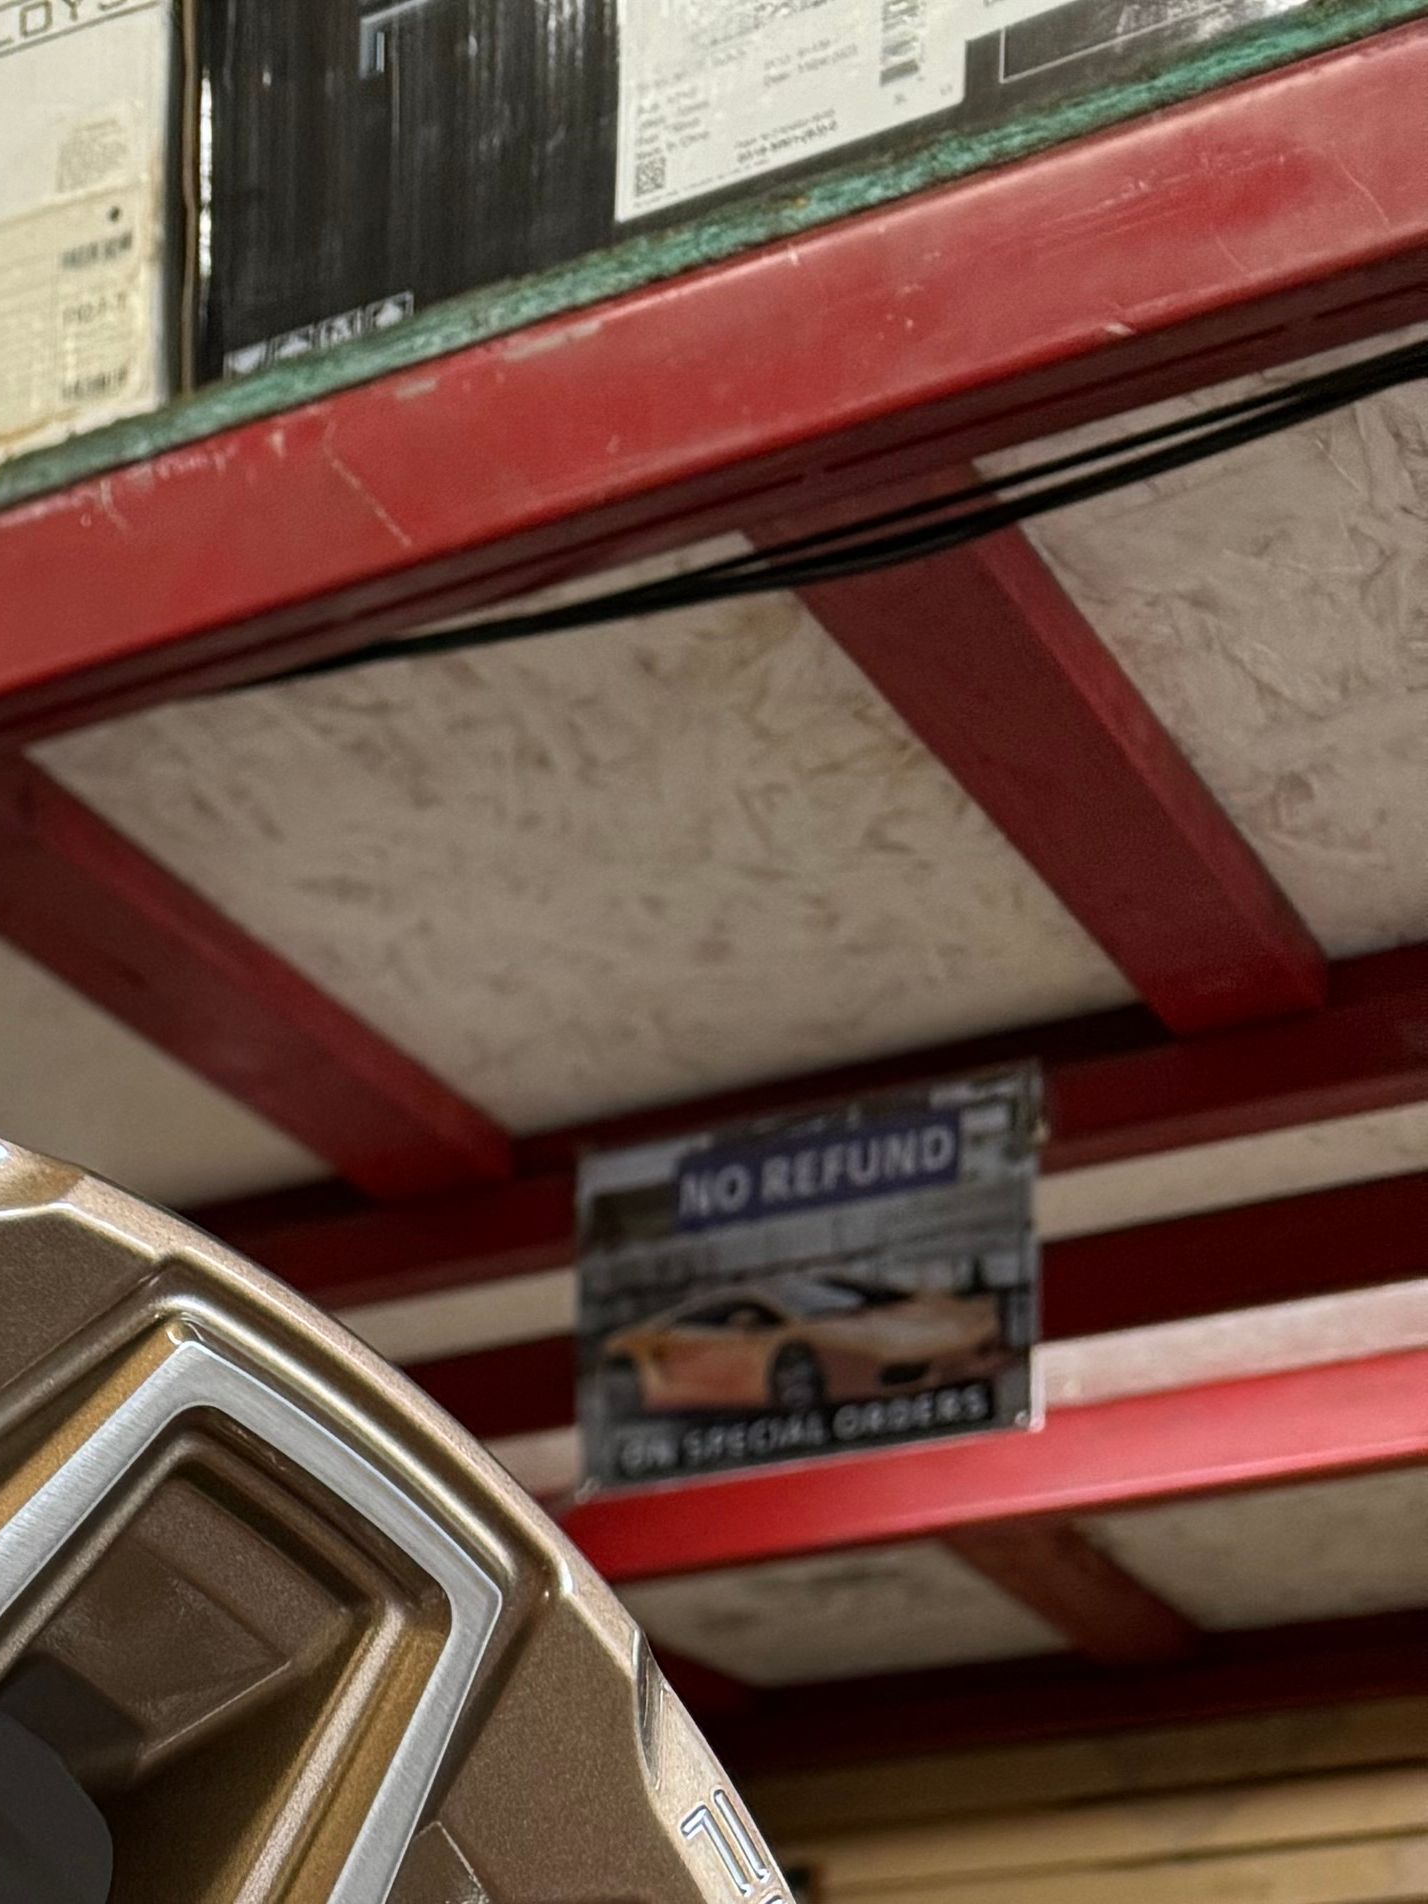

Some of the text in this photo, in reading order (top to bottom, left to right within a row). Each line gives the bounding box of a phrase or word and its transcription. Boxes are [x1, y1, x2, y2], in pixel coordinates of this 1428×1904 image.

[679, 1123, 956, 1219] NO REFUND
[621, 1382, 990, 1472] ON SPECIAL ORDERS
